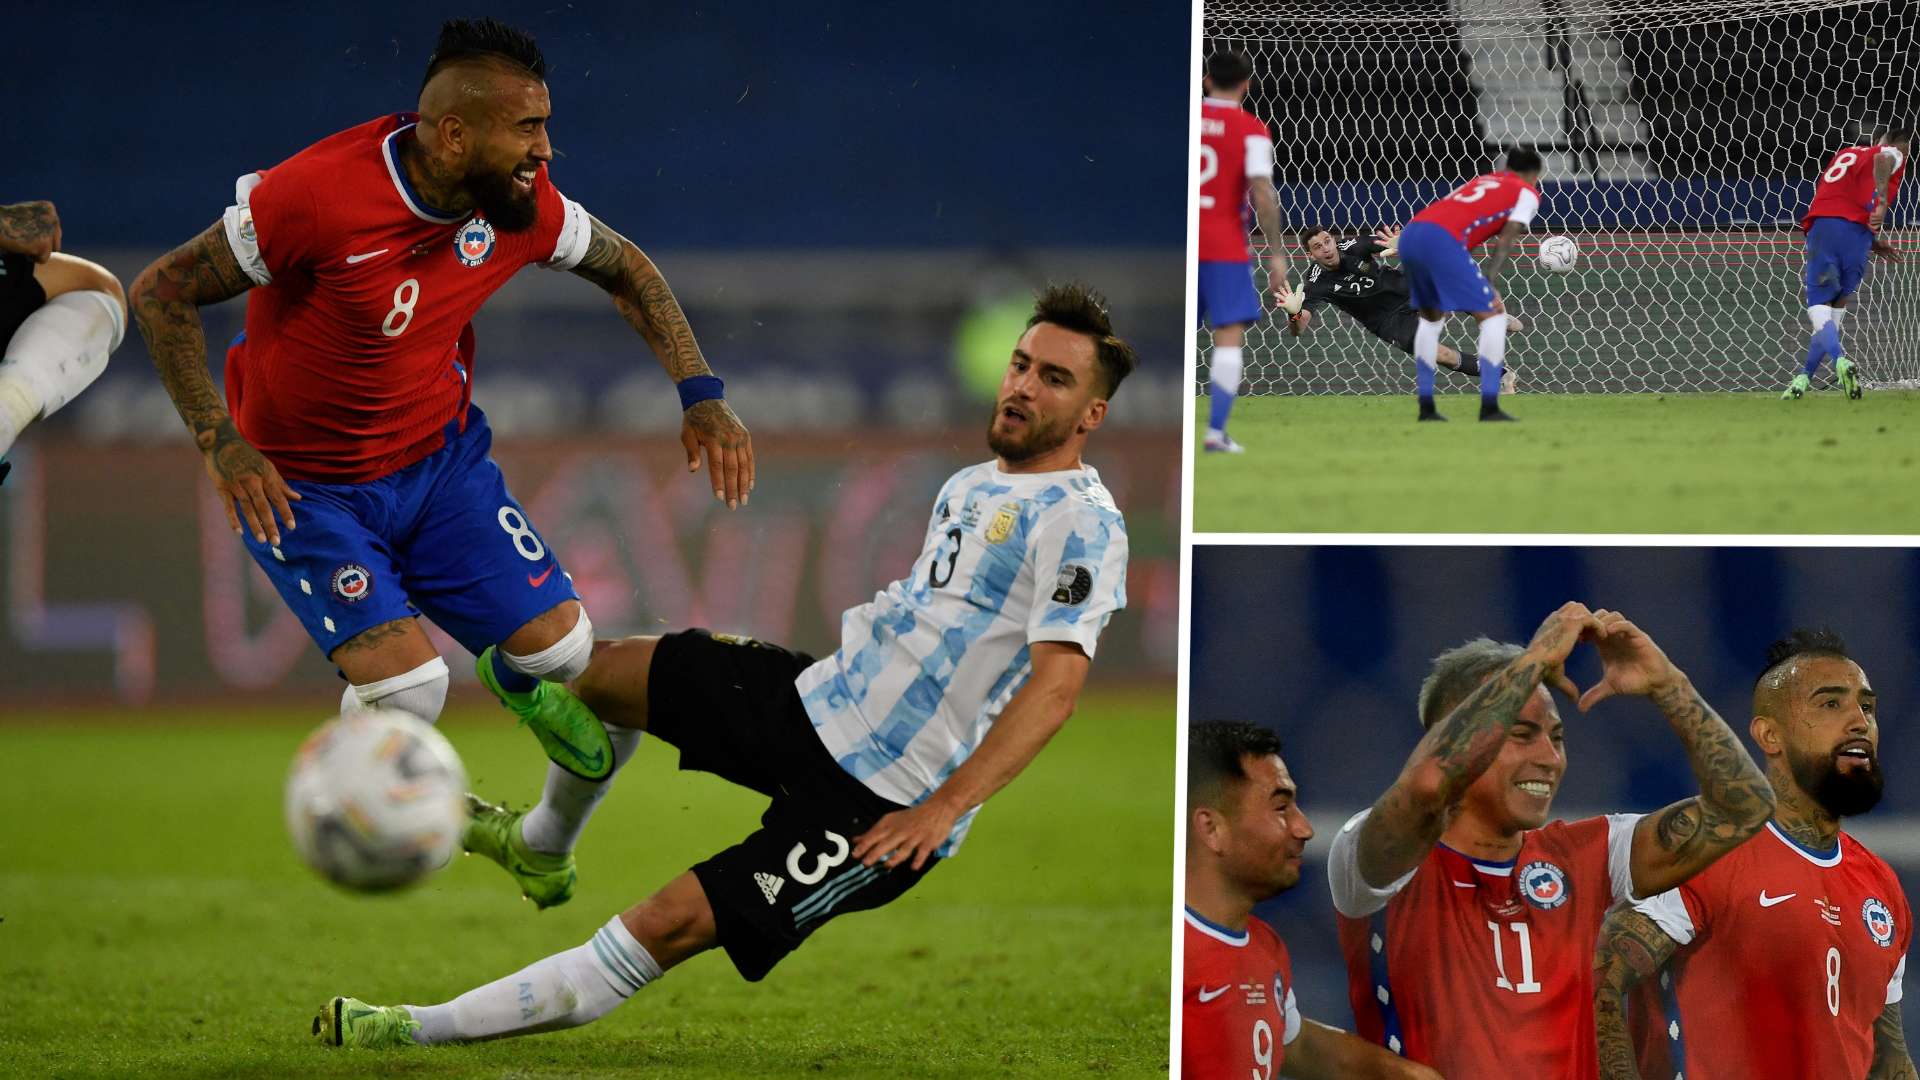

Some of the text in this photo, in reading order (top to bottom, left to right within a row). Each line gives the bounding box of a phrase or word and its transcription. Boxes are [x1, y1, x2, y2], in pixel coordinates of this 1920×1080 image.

[1824, 152, 1857, 183] 8
[382, 278, 419, 336] 8
[498, 506, 545, 561] 8
[929, 528, 962, 588] 3
[786, 830, 849, 885] 3
[1487, 920, 1541, 993] 11
[1826, 947, 1840, 1016] 8
[518, 983, 535, 1020] AFA
[1252, 1019, 1273, 1080] 9
